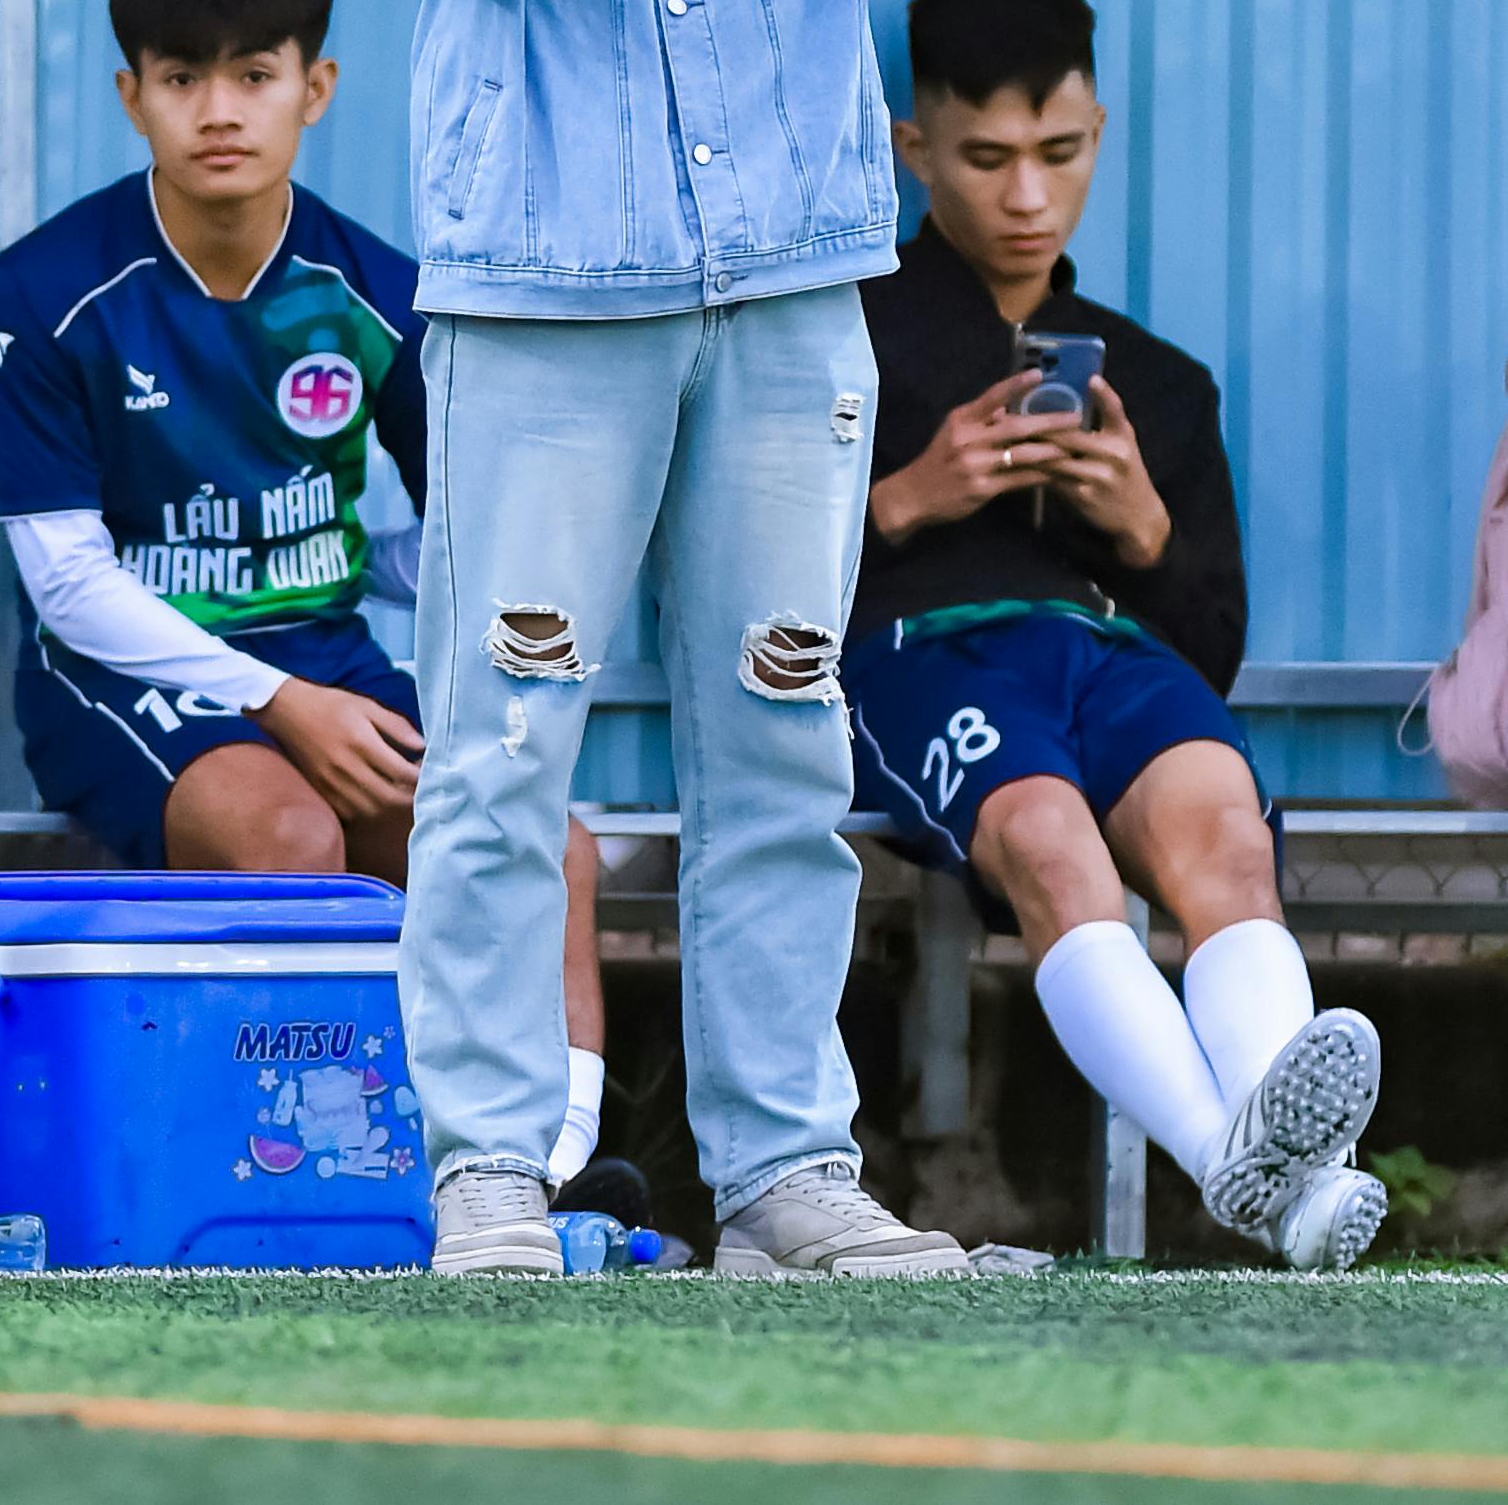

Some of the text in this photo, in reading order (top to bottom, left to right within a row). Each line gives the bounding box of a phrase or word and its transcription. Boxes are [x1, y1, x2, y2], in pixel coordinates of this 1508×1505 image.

[163, 464, 336, 544] LẨU NẤM
[921, 705, 1001, 813] 28
[234, 1022, 356, 1062] MATSU
